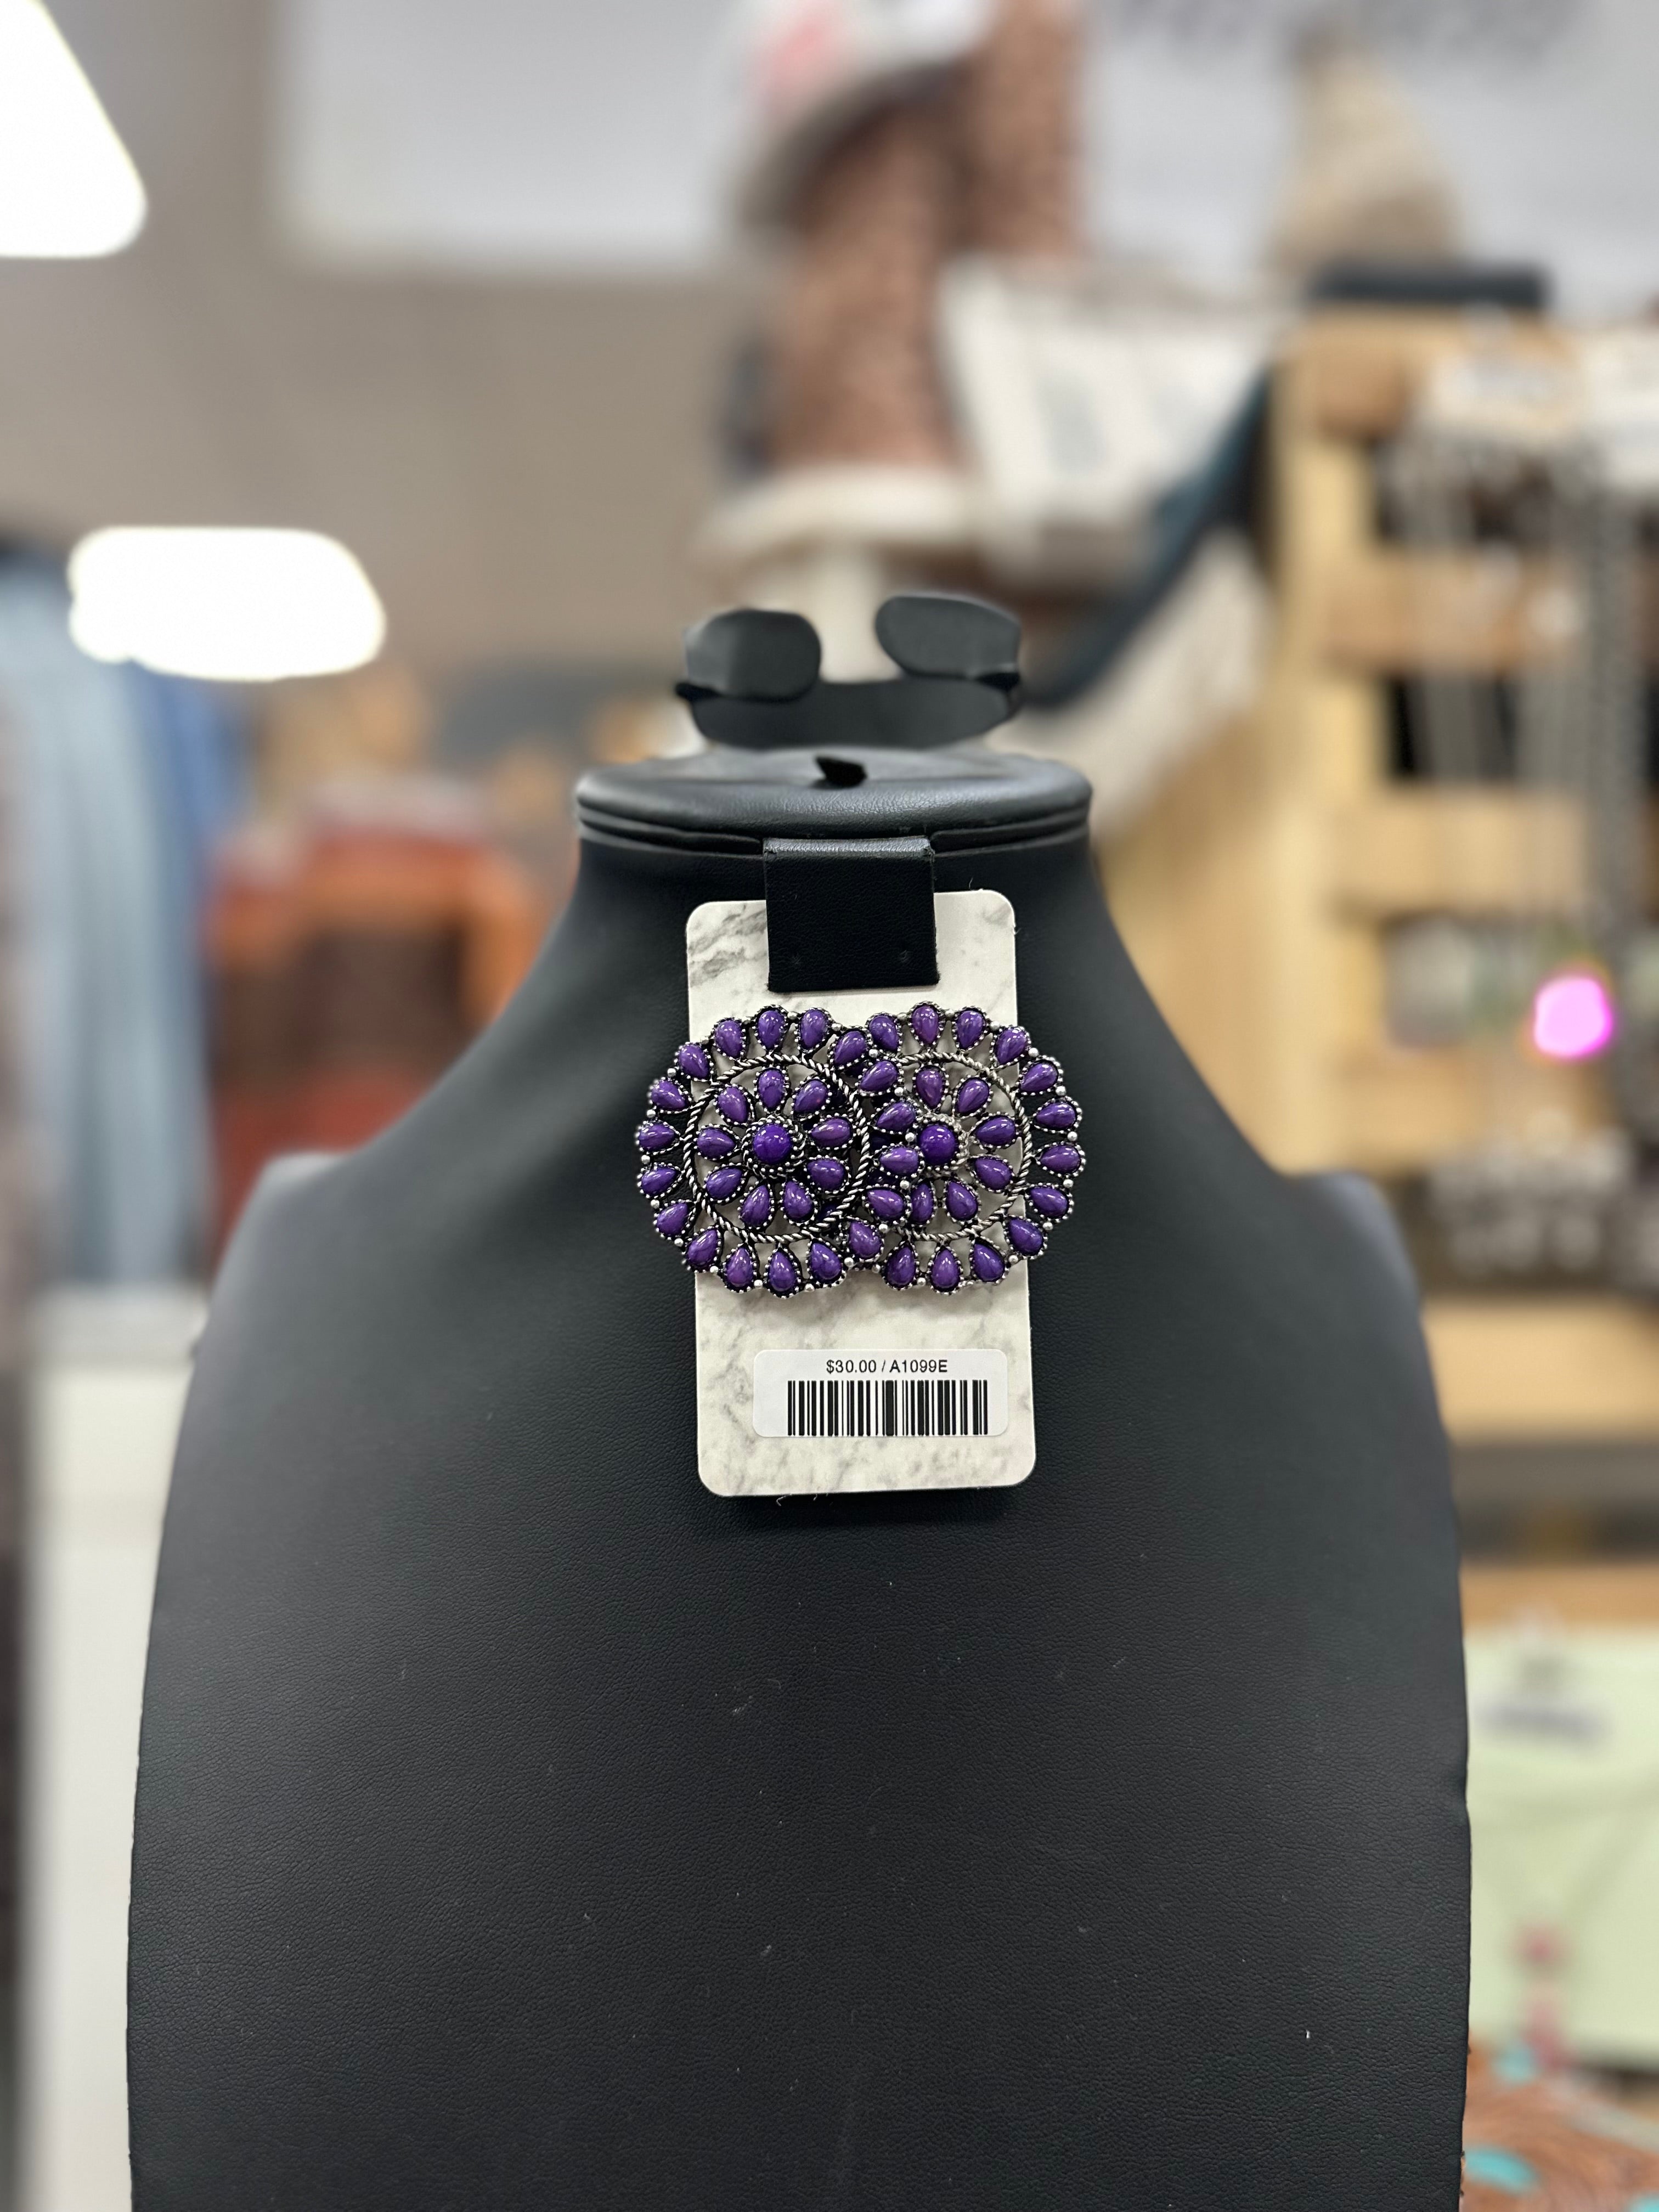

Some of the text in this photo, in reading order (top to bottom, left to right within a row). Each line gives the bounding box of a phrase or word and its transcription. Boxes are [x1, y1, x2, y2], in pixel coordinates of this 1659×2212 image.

[826, 1359, 947, 1374] $30.00 / A1099E
